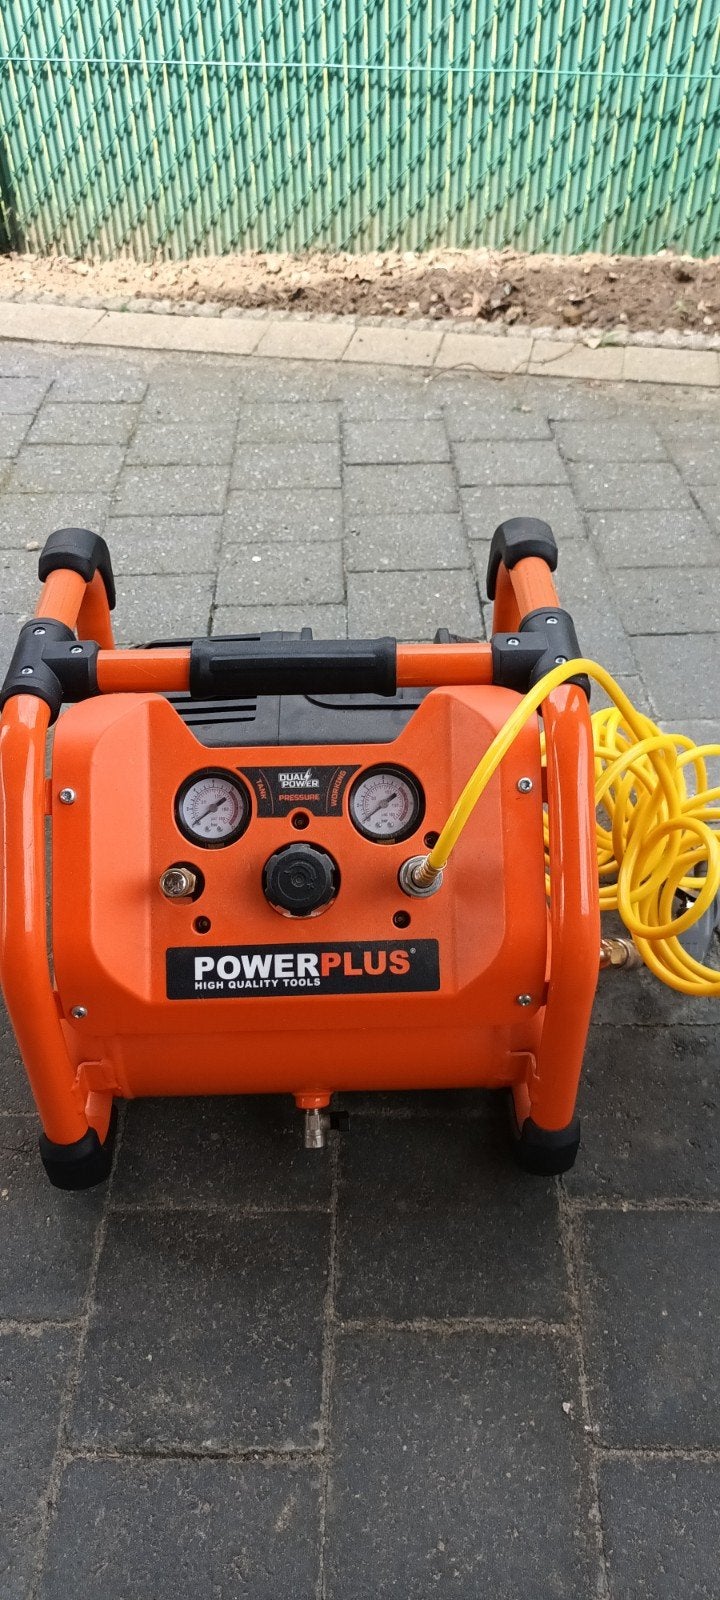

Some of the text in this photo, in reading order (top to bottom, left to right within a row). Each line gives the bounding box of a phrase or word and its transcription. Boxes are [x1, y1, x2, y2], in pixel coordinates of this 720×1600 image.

[279, 773, 306, 781] DUAL
[256, 779, 267, 799] TANK
[282, 780, 319, 788] POWER
[331, 770, 347, 807] WORKING
[279, 793, 320, 801] PRESSURE
[195, 978, 321, 990] HIGH QUALITY TOOLS
